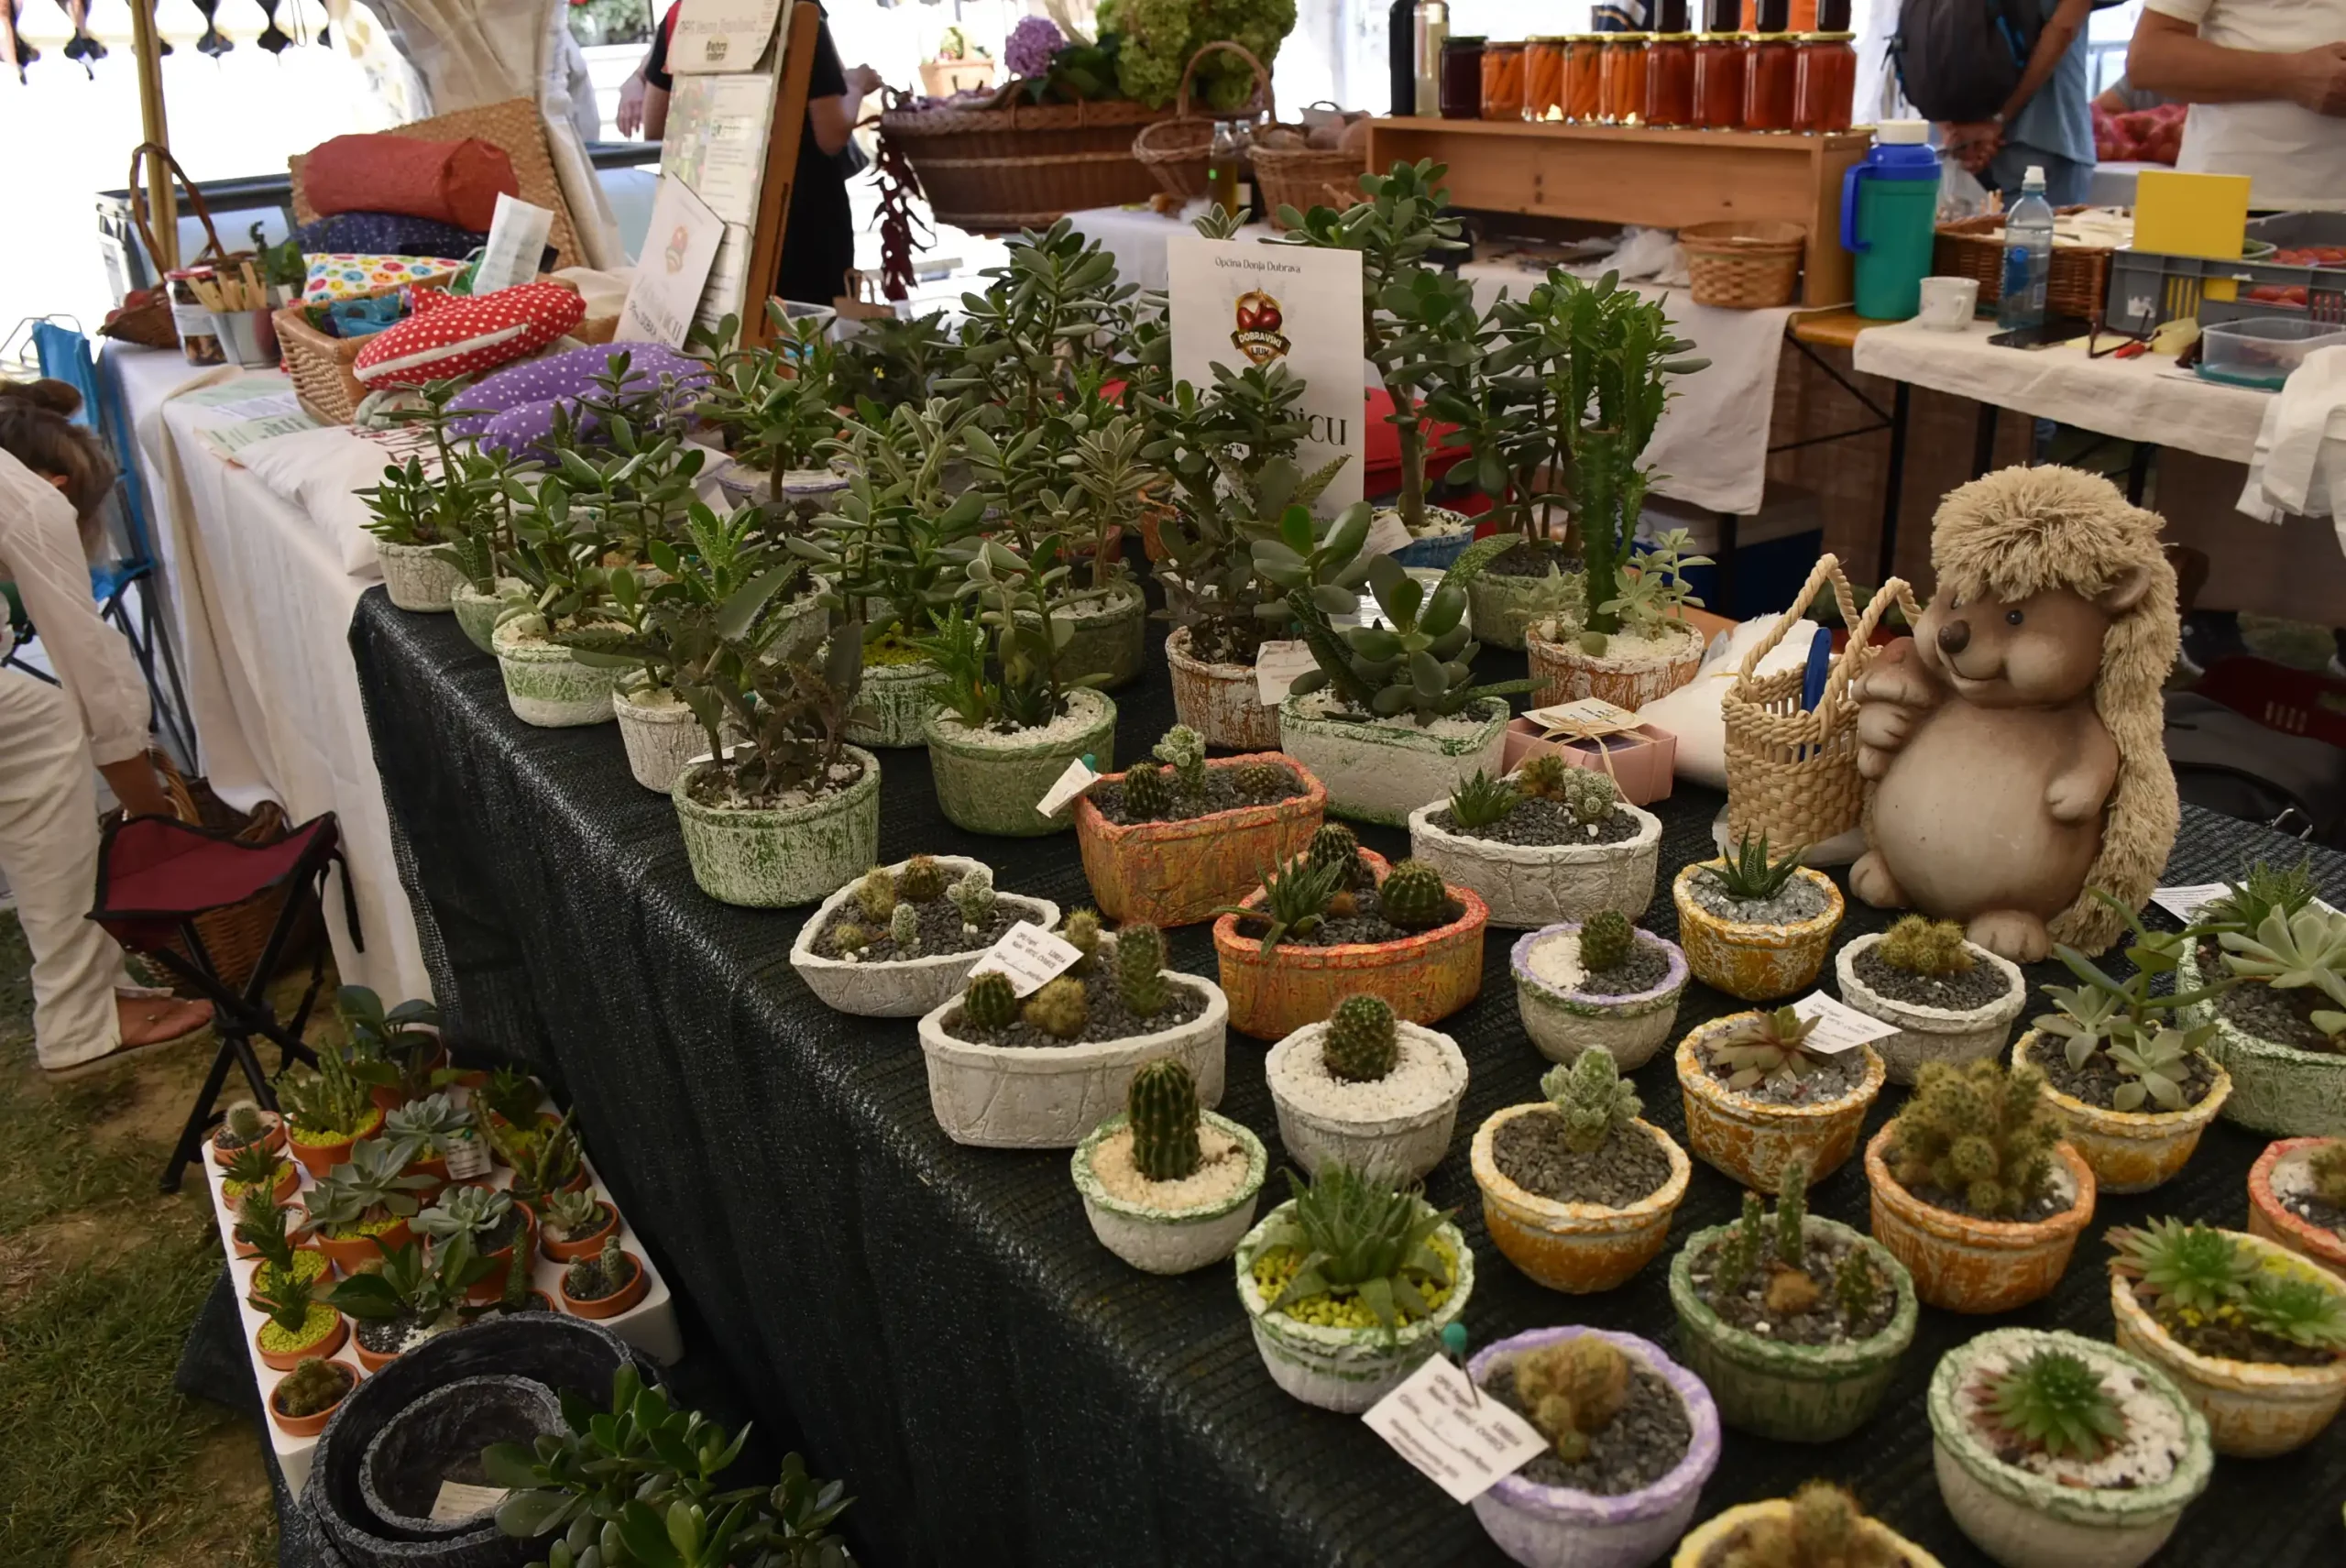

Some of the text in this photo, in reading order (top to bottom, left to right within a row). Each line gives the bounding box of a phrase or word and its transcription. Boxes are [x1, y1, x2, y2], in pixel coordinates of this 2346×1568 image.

[1243, 259, 1266, 271] Donja
[1266, 261, 1301, 274] Dubrava
[1238, 331, 1282, 348] DOBRAVSKI
